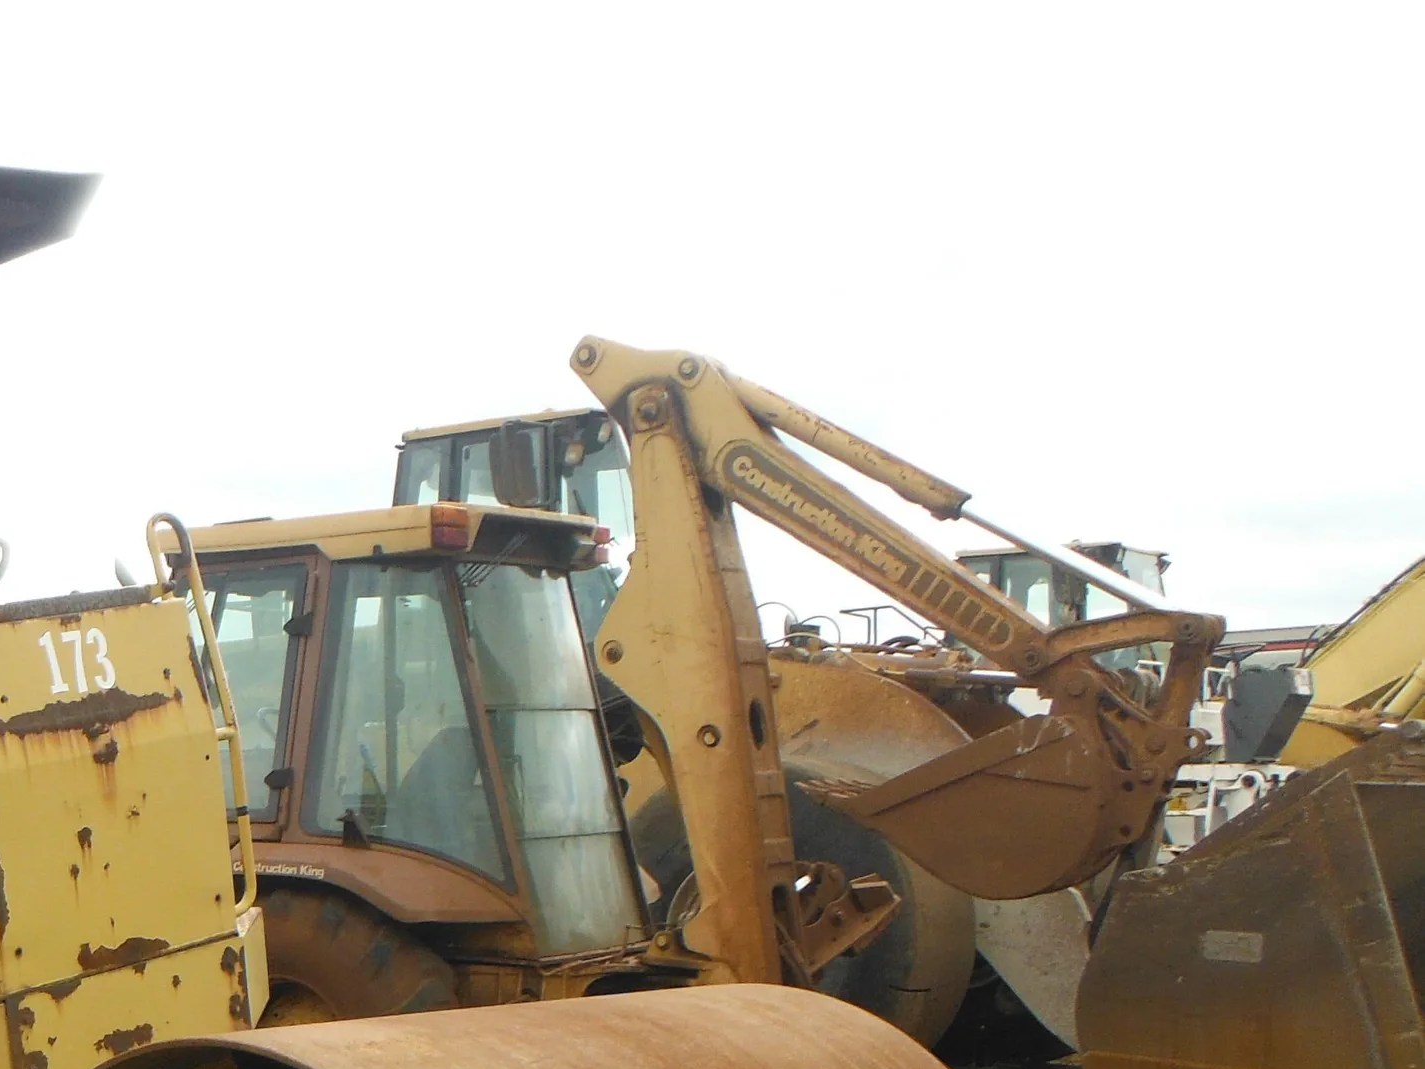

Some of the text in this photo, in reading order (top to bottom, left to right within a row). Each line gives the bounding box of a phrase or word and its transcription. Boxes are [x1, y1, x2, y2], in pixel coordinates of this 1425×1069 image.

[732, 455, 908, 583] Construction King
[38, 627, 116, 695] 173
[233, 861, 325, 880] Ctruction King
